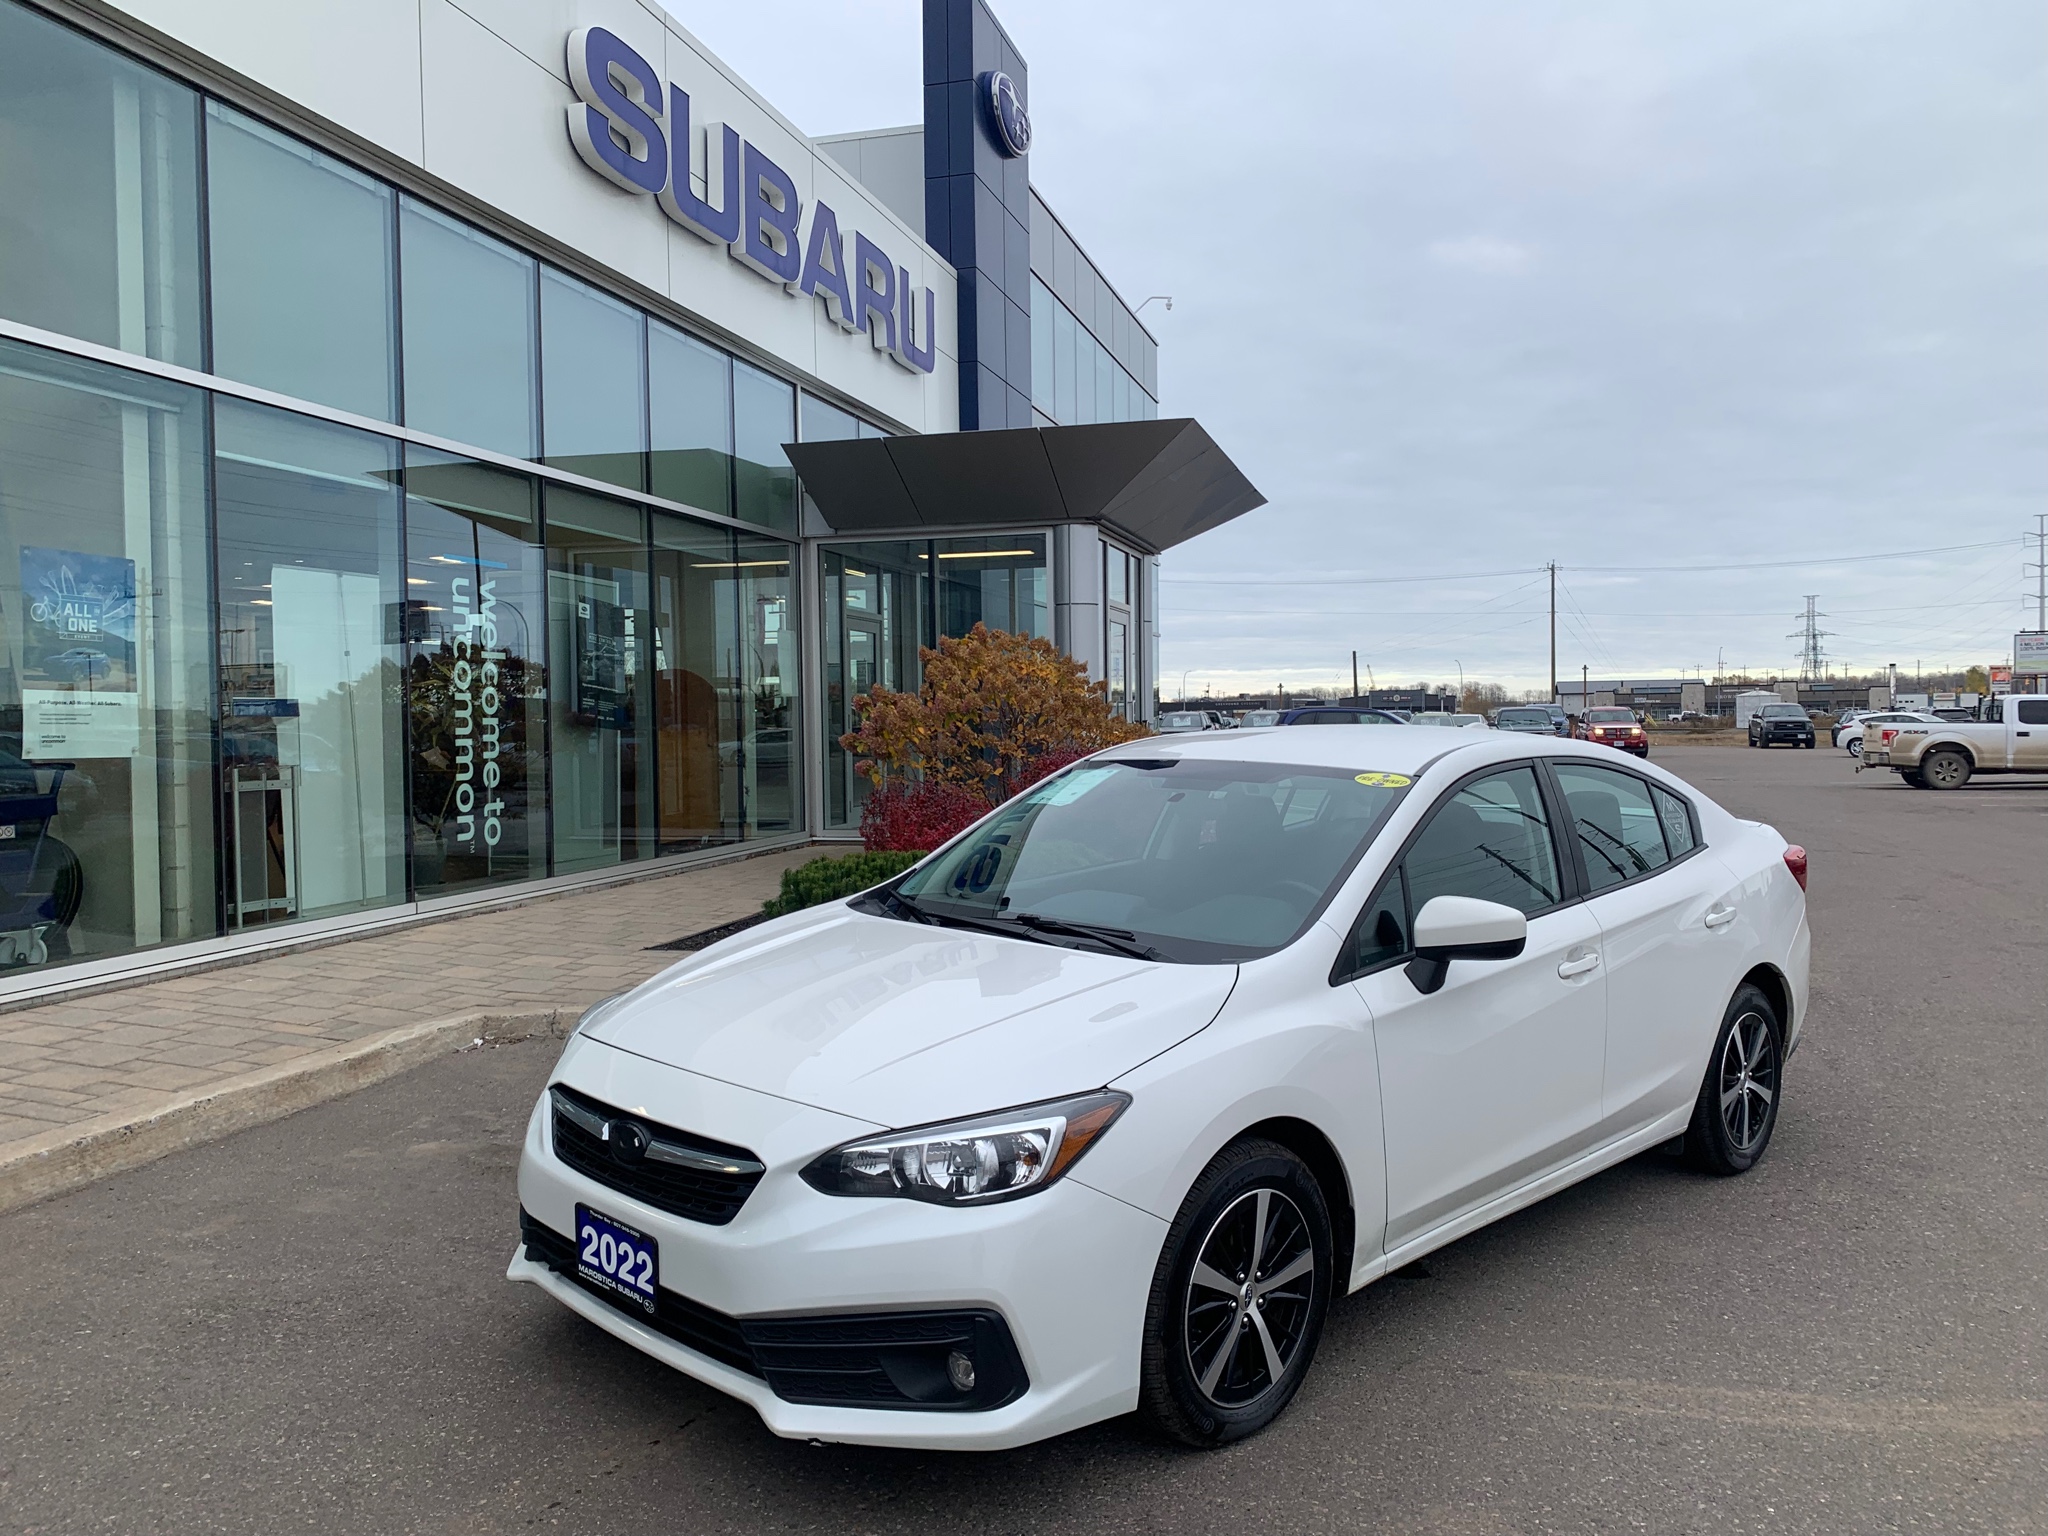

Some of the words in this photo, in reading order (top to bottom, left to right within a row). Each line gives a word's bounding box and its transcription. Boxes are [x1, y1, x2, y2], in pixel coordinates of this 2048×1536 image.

[568, 26, 935, 374] SUBARU
[64, 603, 92, 617] ALL
[68, 618, 97, 632] ONE
[480, 580, 506, 789] welcome
[484, 797, 505, 846] to
[578, 1264, 617, 1289] MAROSTICA
[617, 1283, 643, 1303] SUBARU
[582, 1225, 654, 1295] 2022
